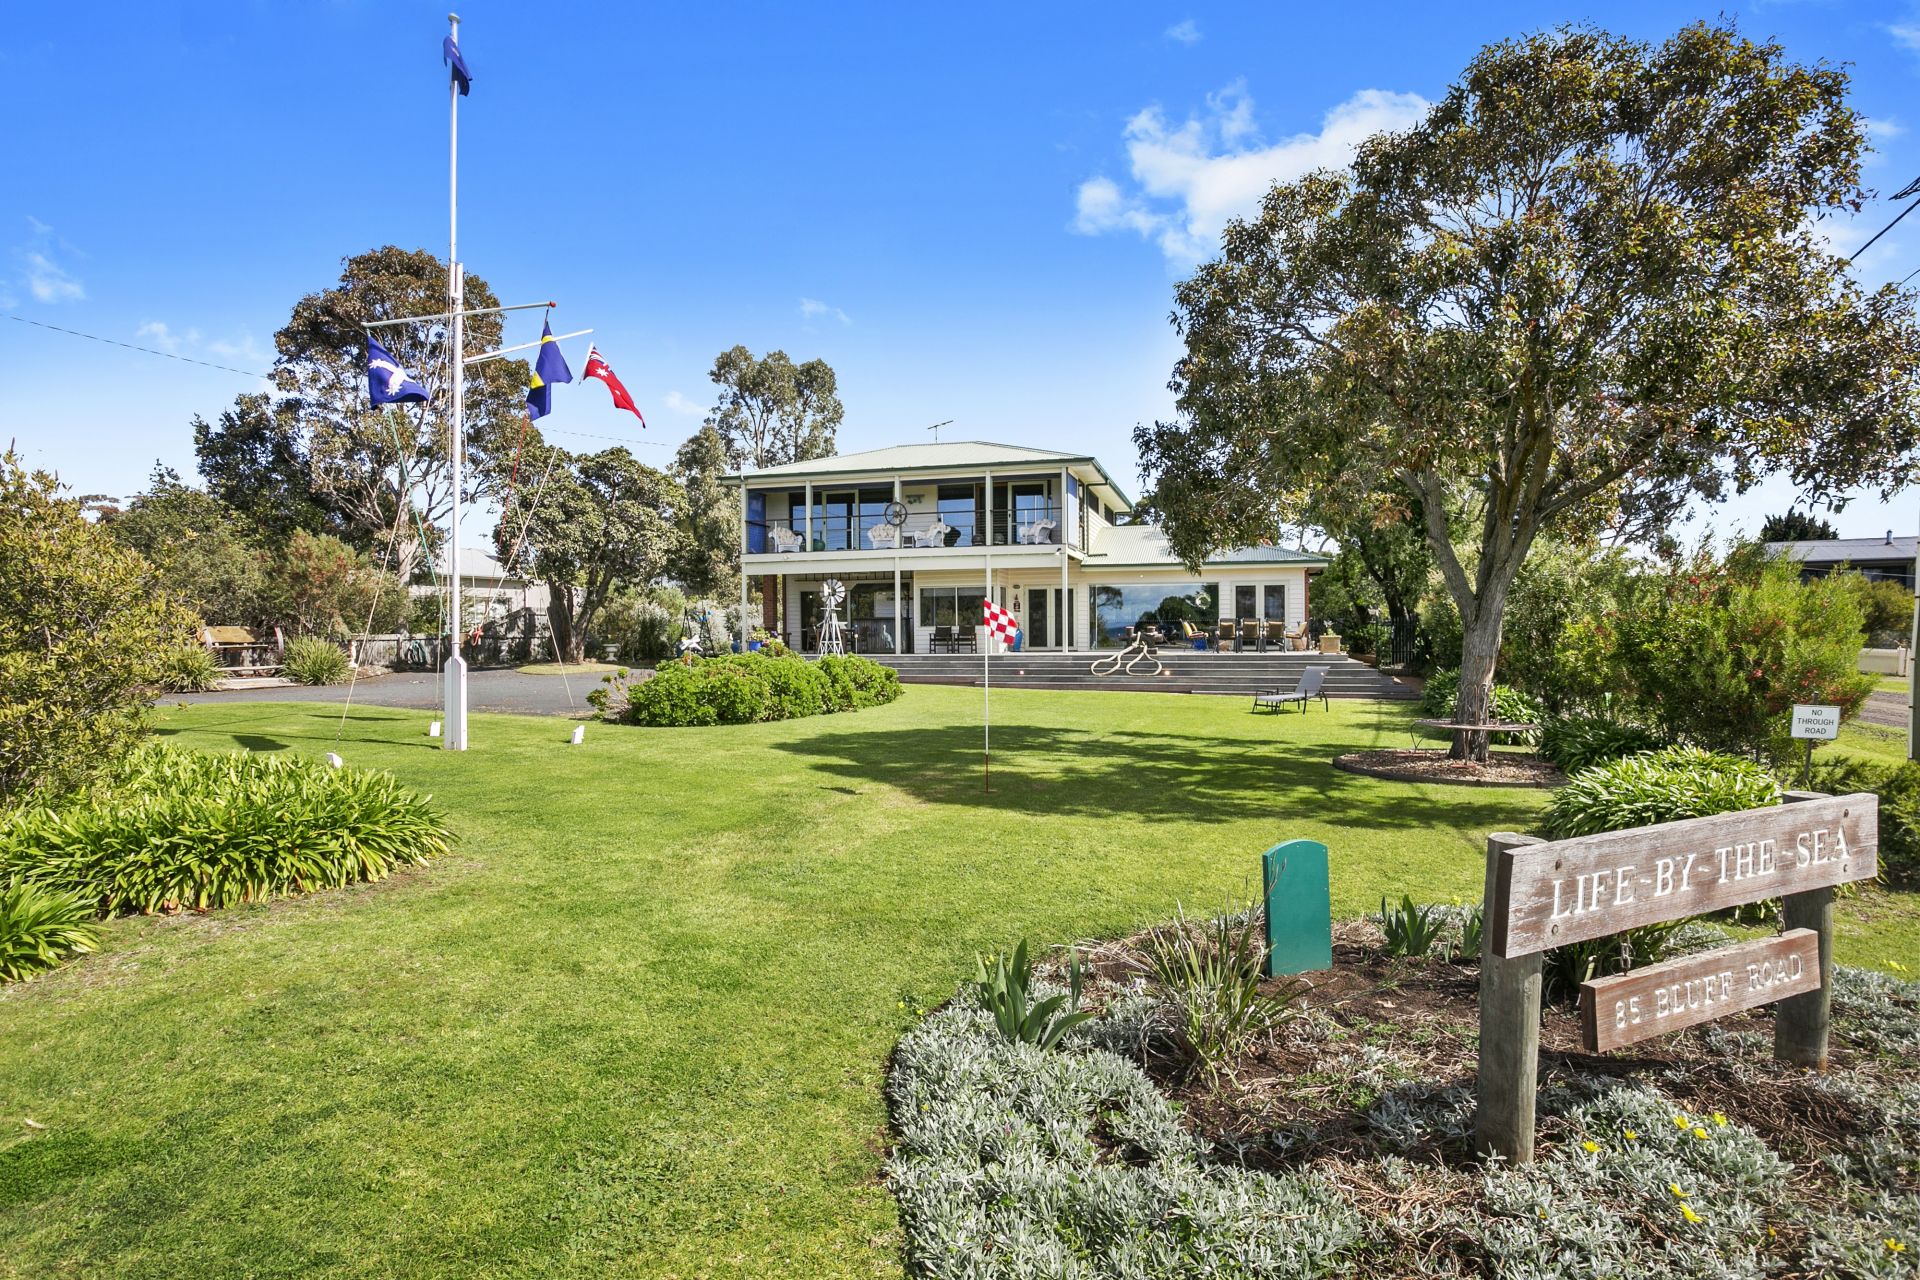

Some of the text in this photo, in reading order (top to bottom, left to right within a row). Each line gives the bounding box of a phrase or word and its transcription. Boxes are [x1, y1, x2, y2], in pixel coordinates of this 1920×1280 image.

[1797, 717, 1834, 726] THROUGH
[1804, 727, 1827, 735] ROAD
[1614, 953, 1805, 1029] 85 BLUFF ROAD
